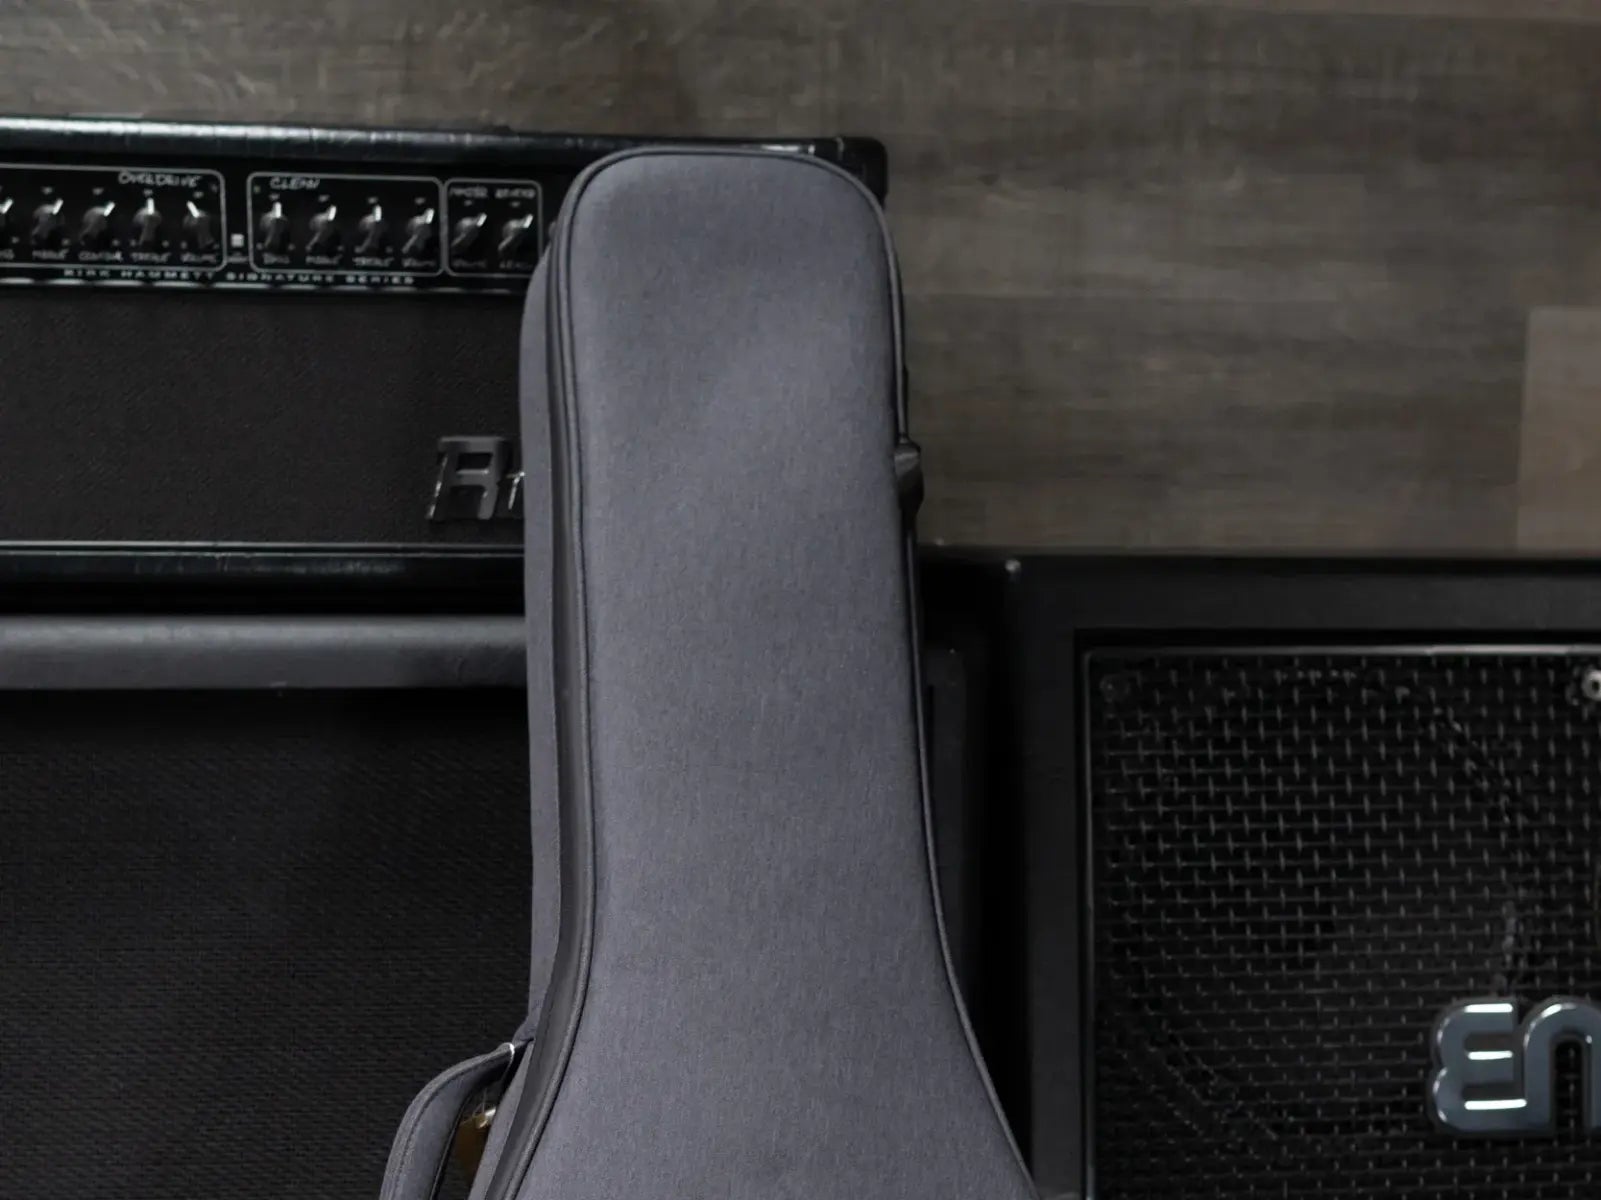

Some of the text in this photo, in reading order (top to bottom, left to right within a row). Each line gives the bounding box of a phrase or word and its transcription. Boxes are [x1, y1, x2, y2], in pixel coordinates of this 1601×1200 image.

[270, 177, 320, 189] CLEAN
[226, 272, 334, 282] SIGNATURE
[345, 275, 414, 285] SERIES
